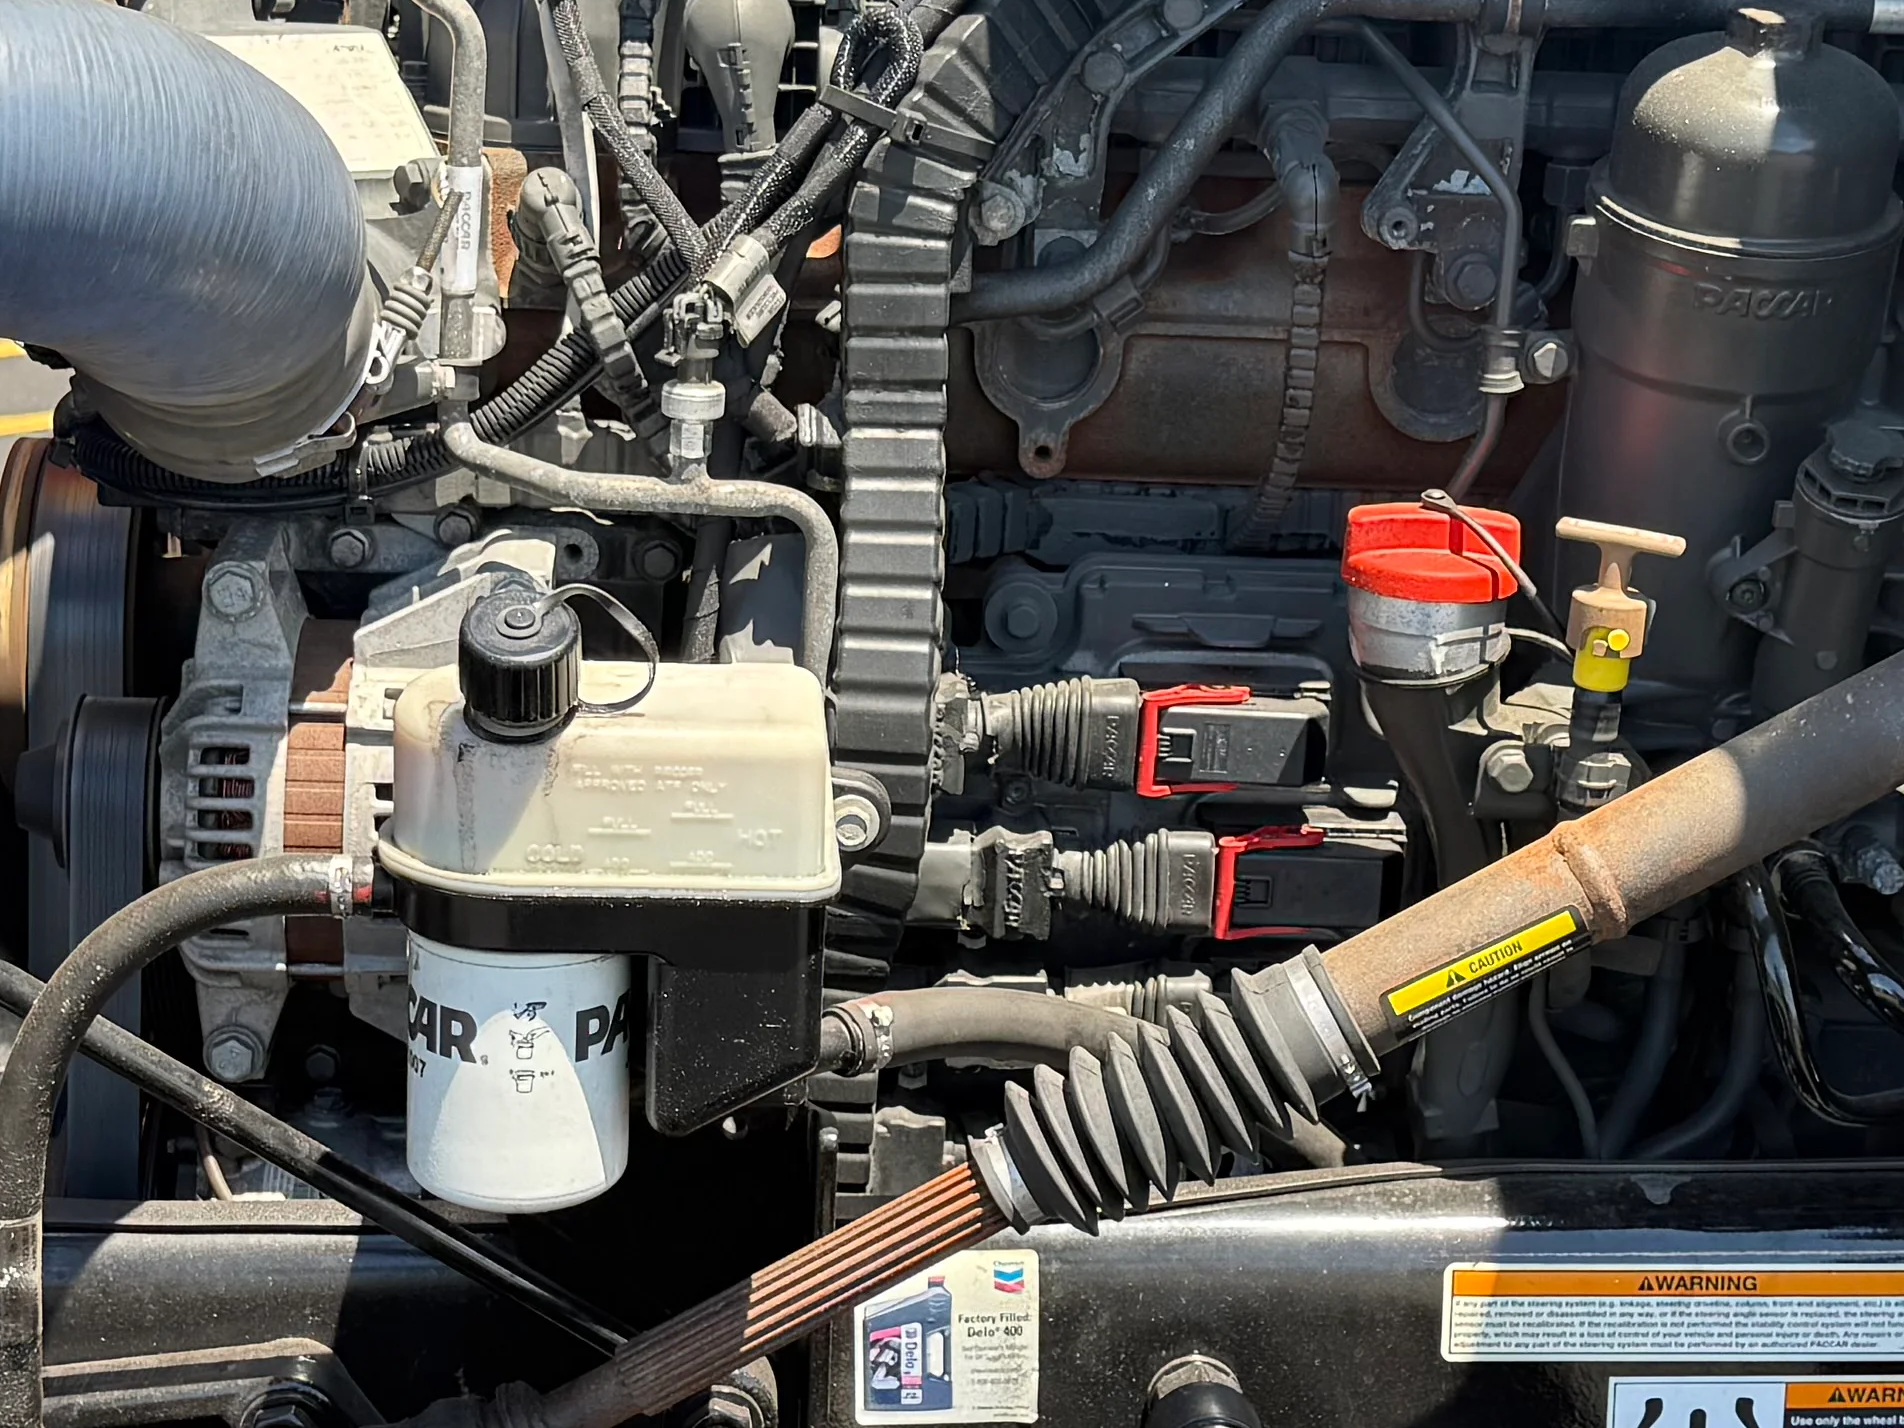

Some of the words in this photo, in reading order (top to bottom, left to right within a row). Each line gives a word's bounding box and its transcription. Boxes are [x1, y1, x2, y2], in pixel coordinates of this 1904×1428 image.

[460, 191, 472, 250] PACCAR
[575, 778, 647, 792] APPROVED
[737, 828, 784, 847] HOT
[526, 843, 584, 863] COLD
[1181, 853, 1197, 917] PACCAR
[1469, 939, 1523, 974] CAUTION
[1655, 1275, 1758, 1291] WARNING
[958, 1313, 996, 1325] Factory
[967, 1327, 994, 1337] Delo
[1003, 1325, 1023, 1337] 400
[905, 1341, 918, 1370] Delo
[1790, 1416, 1812, 1425] Use
[1815, 1417, 1839, 1426] only
[1842, 1416, 1860, 1425] the
[1863, 1416, 1896, 1425] wheel
